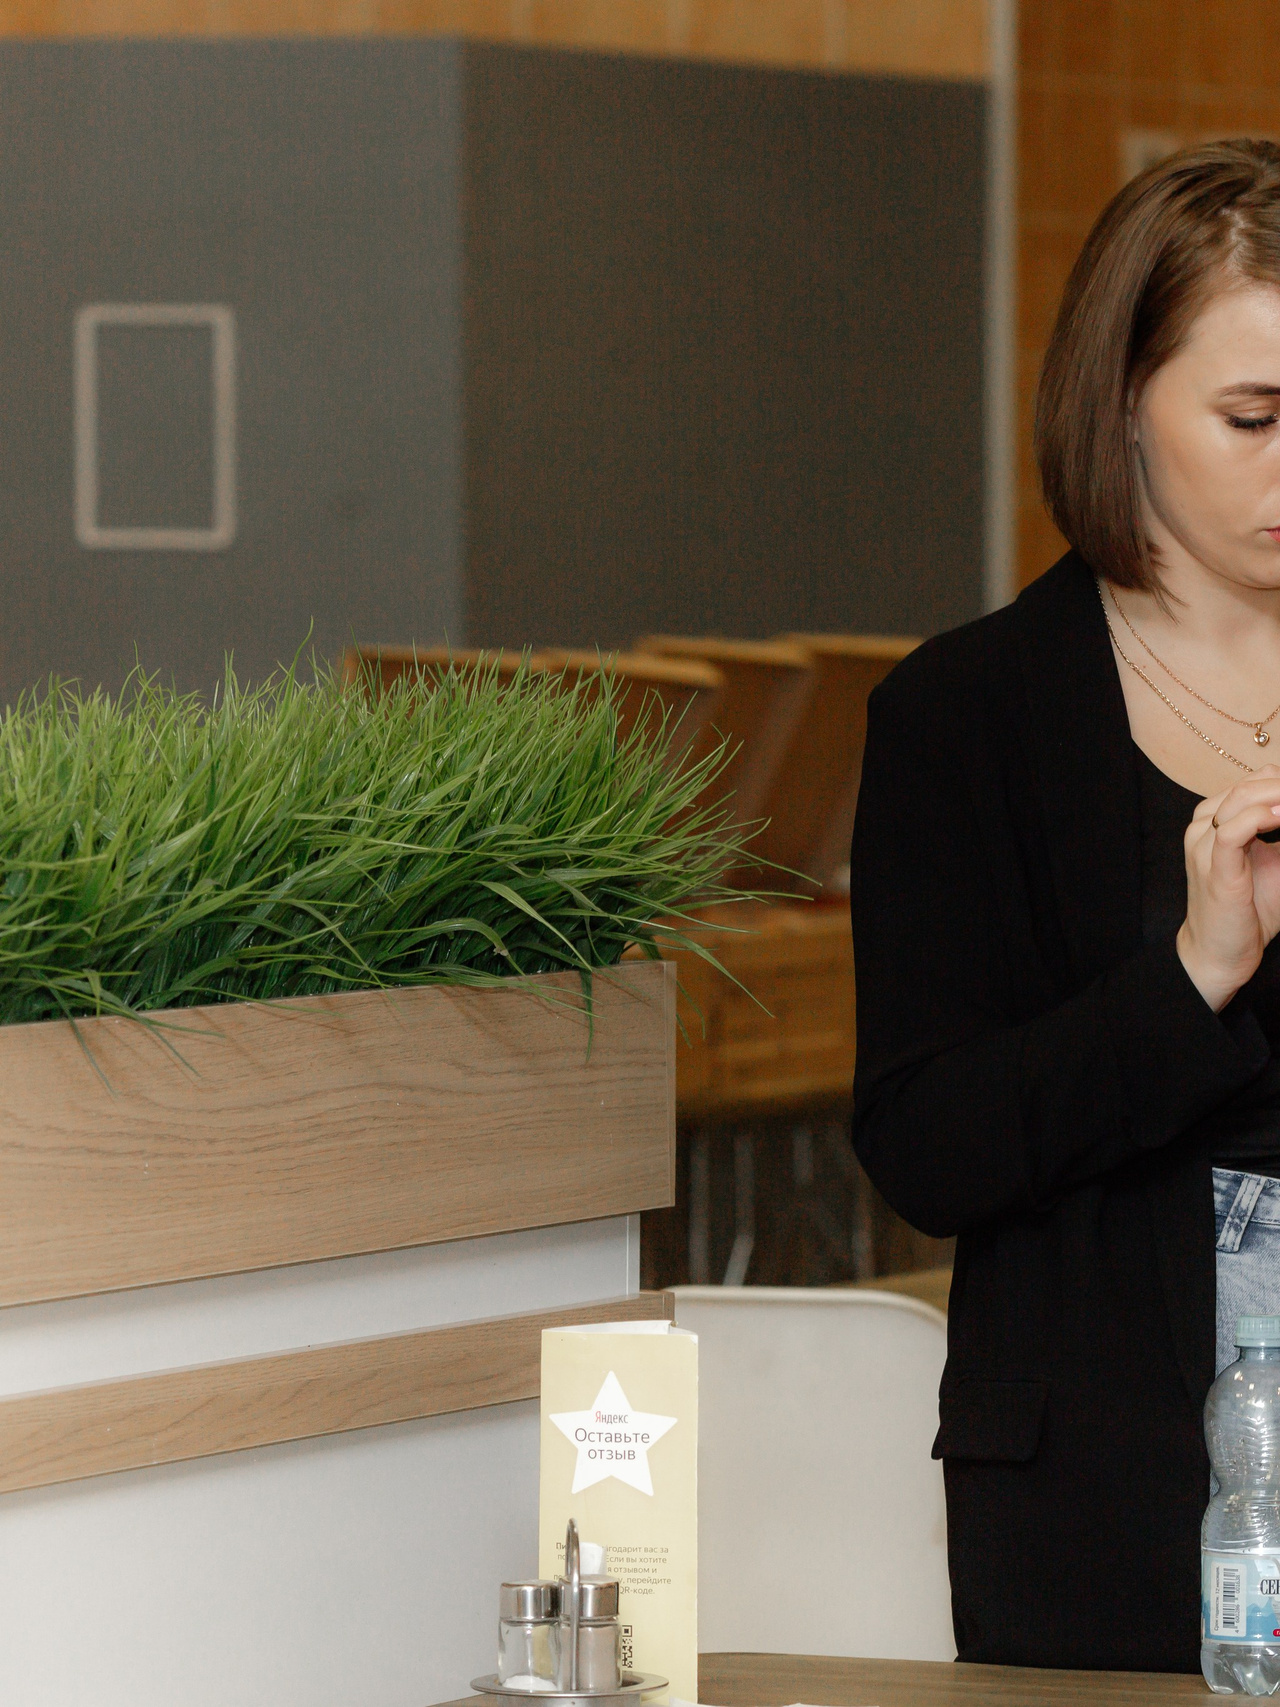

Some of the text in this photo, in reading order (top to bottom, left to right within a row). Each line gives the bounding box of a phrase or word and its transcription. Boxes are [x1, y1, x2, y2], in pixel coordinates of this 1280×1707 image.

[595, 1411, 629, 1424] Яндекс
[574, 1427, 650, 1444] Оставьте
[587, 1448, 636, 1460] отзыв
[613, 1566, 650, 1574] отзывом
[626, 1576, 672, 1585] перейдите
